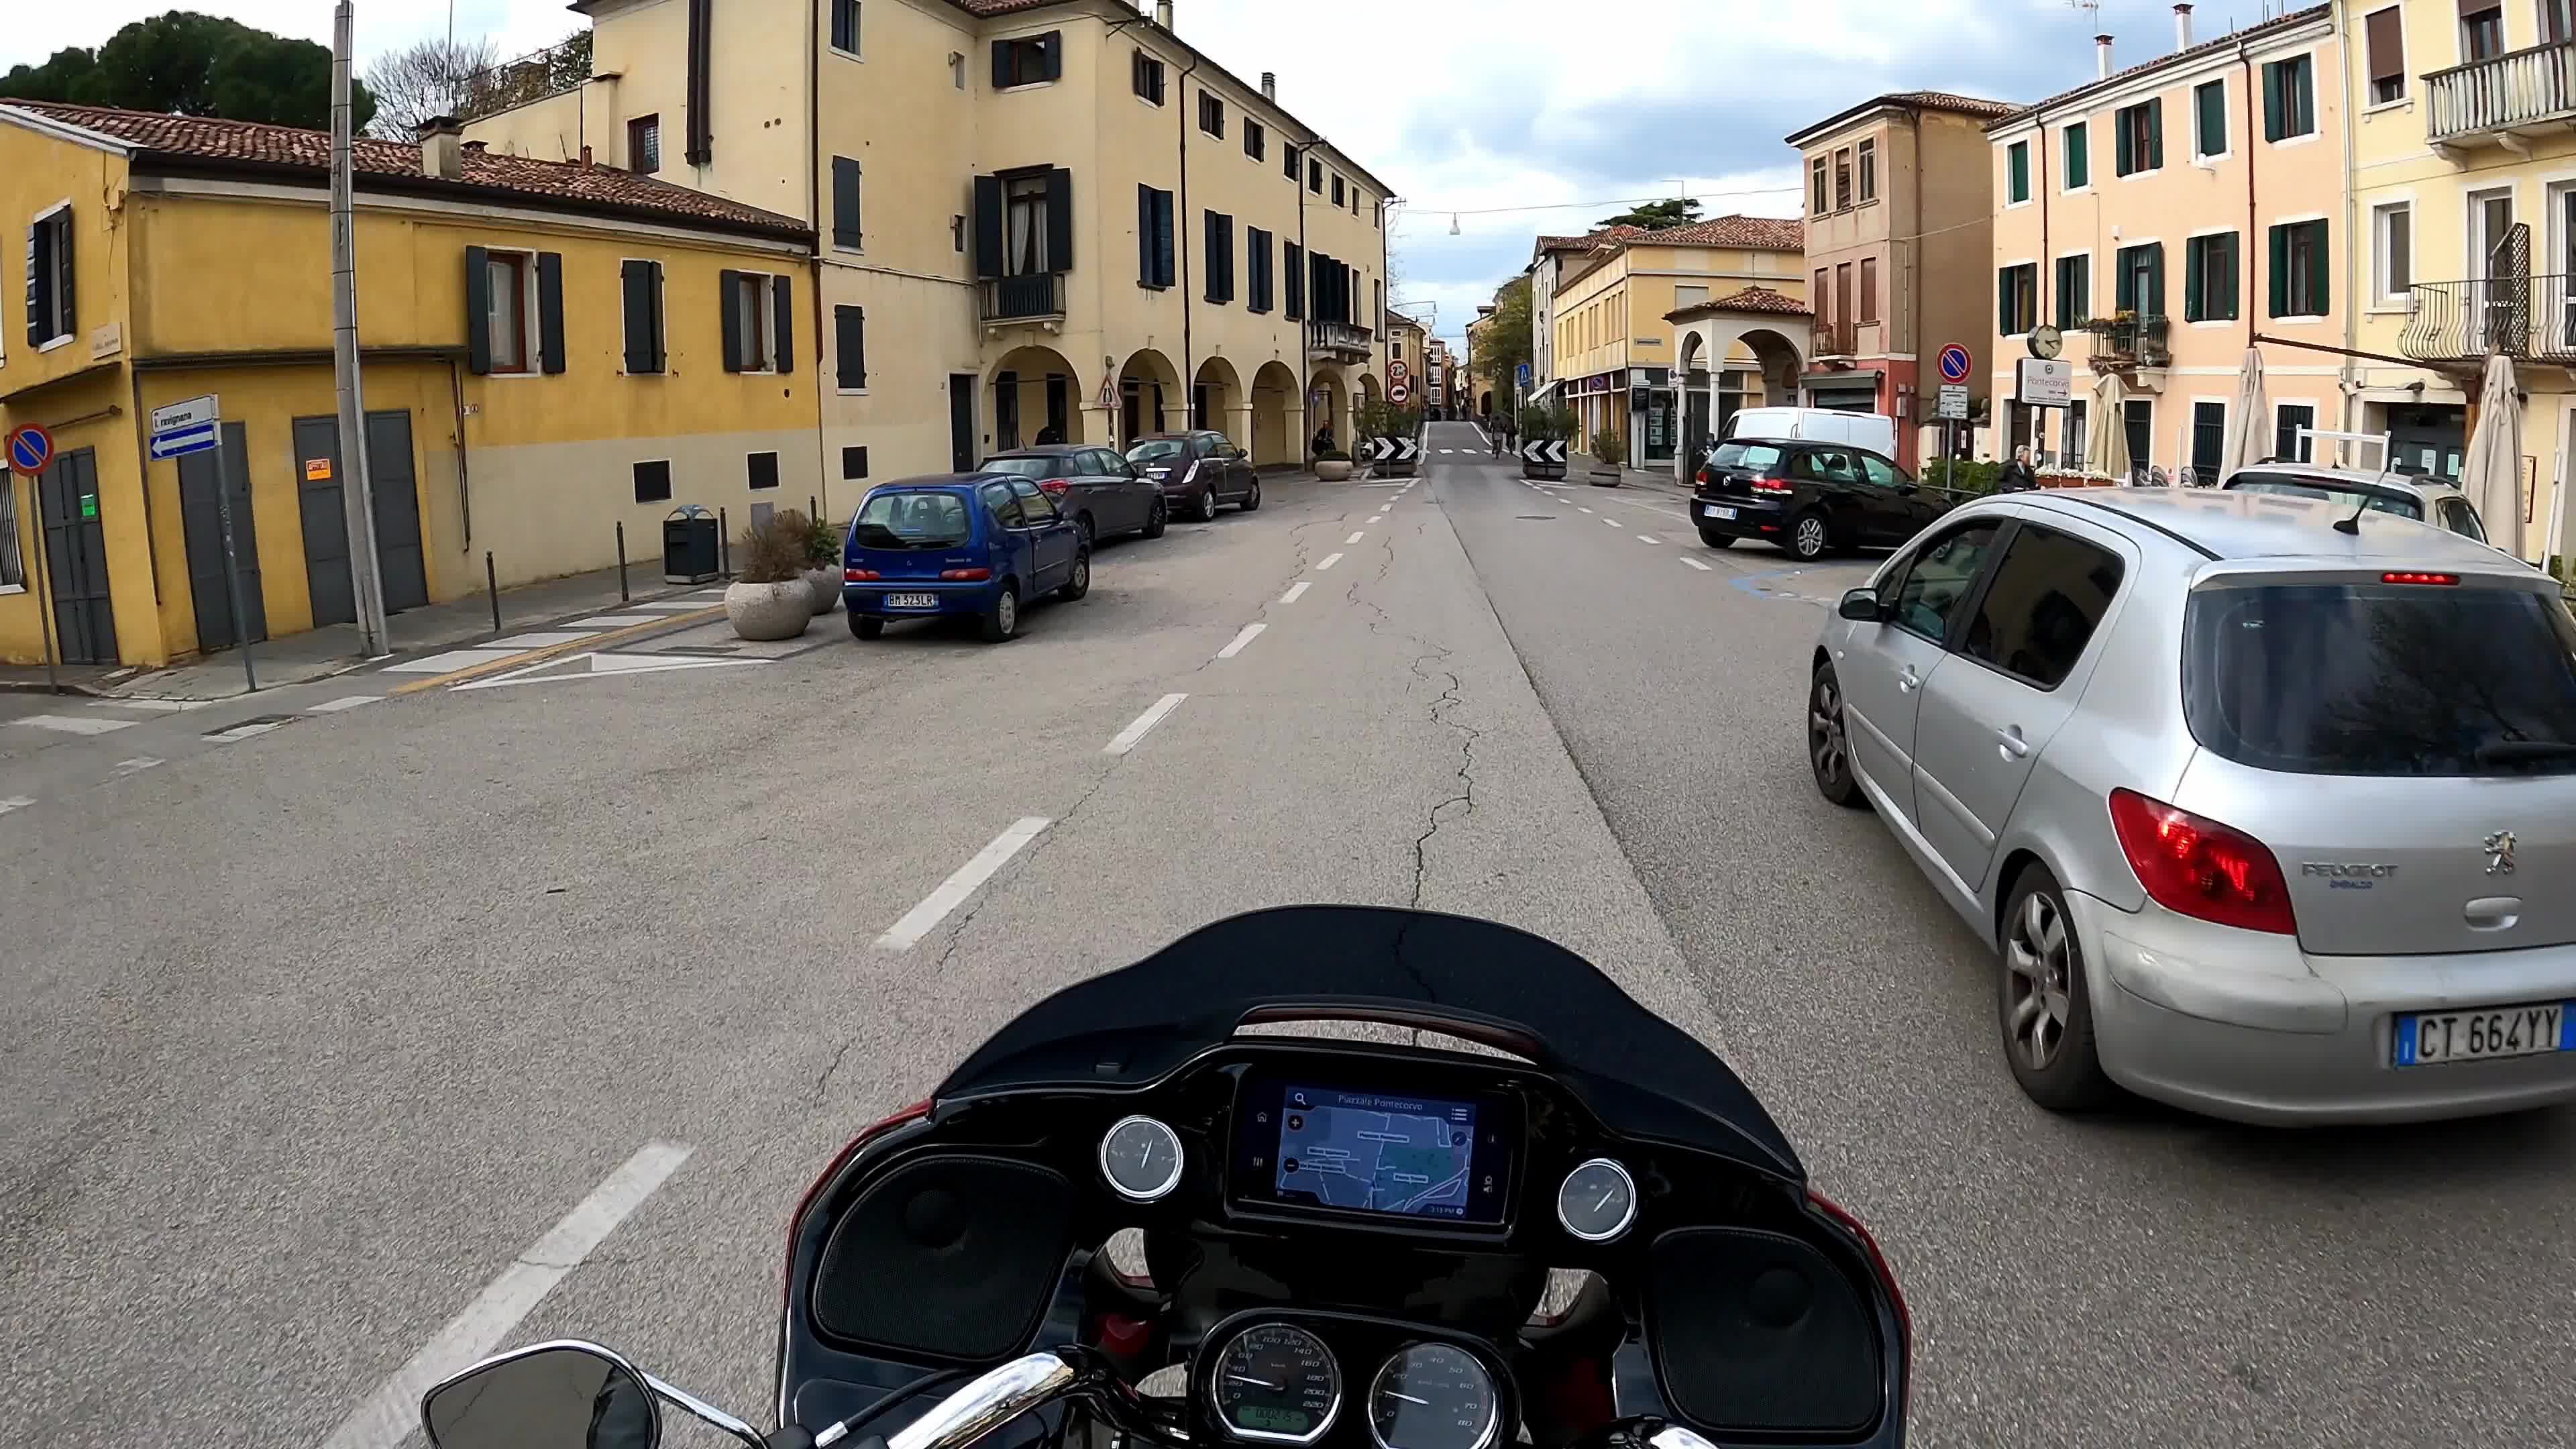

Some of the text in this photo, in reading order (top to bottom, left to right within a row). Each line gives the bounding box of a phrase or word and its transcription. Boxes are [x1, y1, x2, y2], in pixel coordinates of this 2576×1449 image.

[2302, 861, 2399, 878] PEUGEOT
[2420, 1017, 2458, 1058] CT
[2469, 1008, 2559, 1054] 664YY
[1338, 1094, 1423, 1111] Piazzale Pontecorvo
[1302, 1400, 1324, 1408] 220
